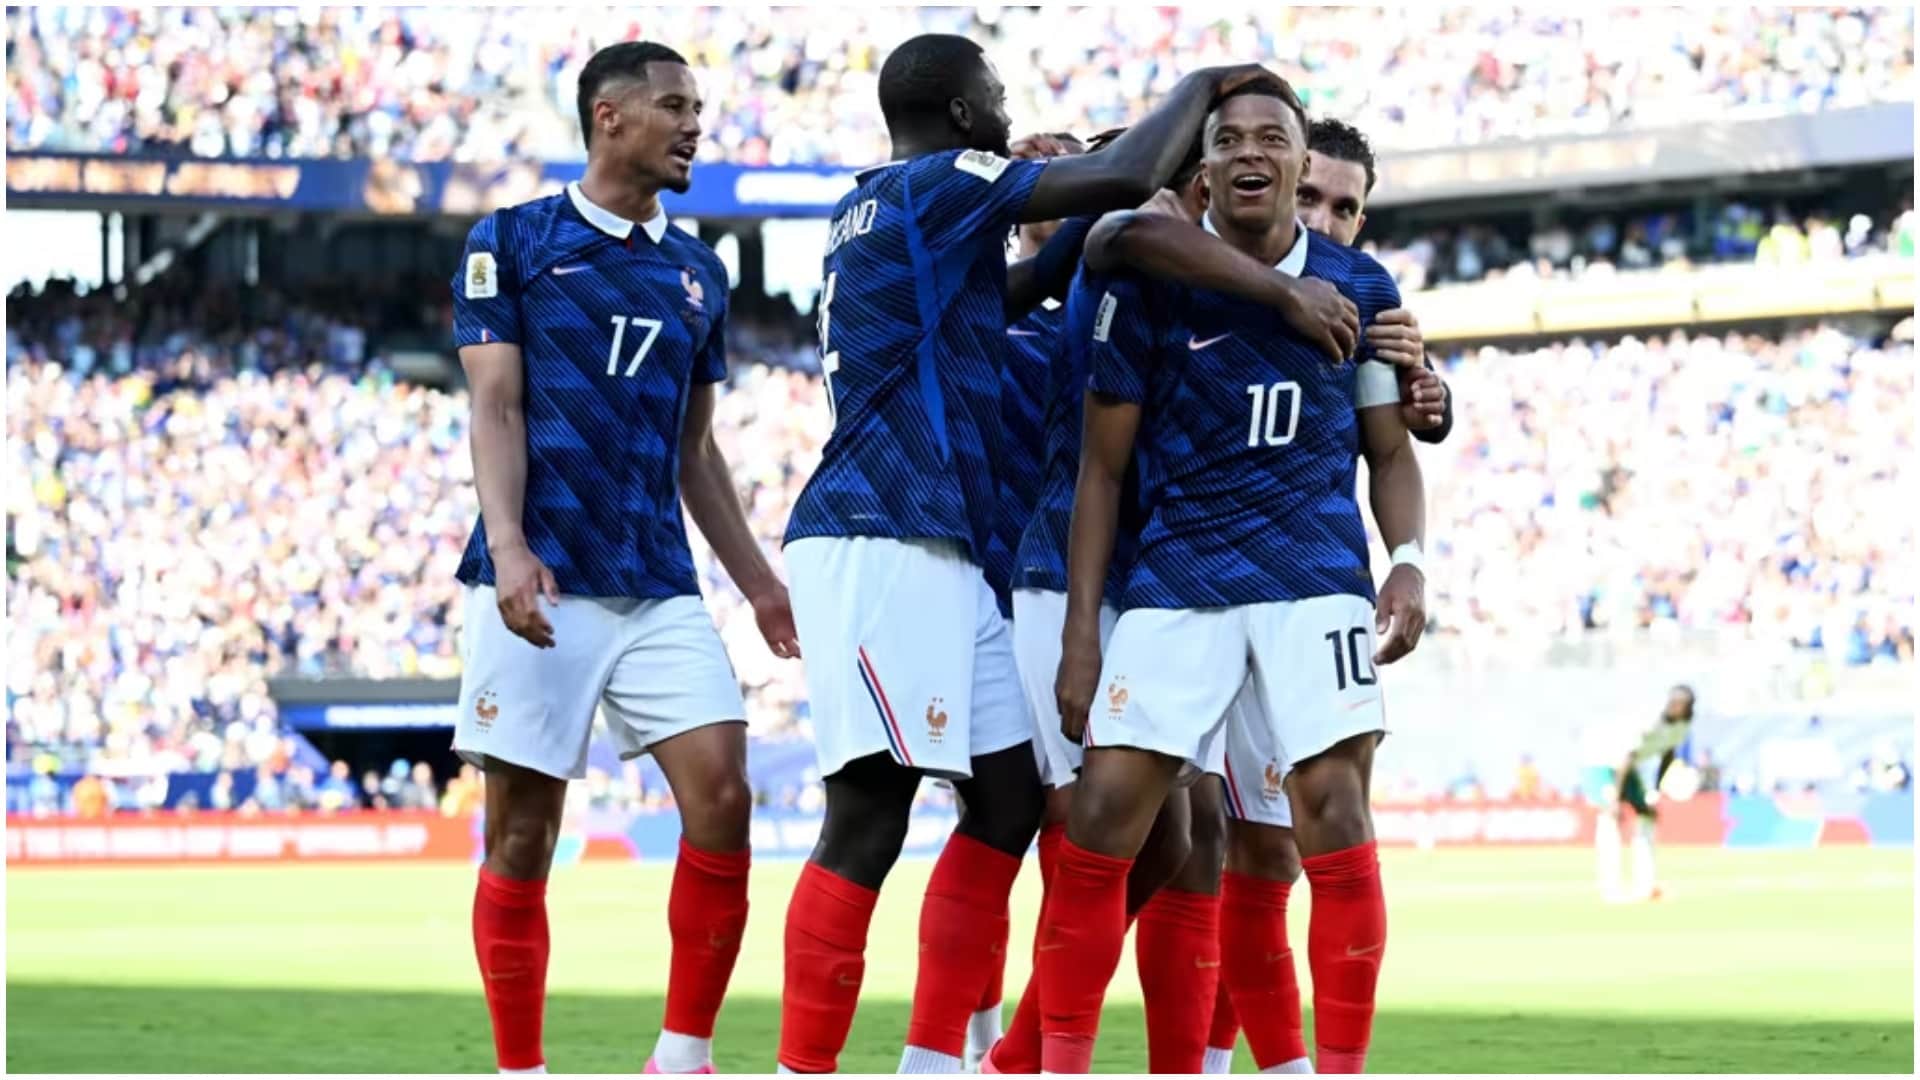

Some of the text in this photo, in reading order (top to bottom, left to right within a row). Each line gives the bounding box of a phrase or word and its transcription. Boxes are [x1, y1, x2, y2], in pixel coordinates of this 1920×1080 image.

[606, 315, 664, 377] 17
[1246, 381, 1302, 447] 10
[1324, 626, 1378, 691] 10
